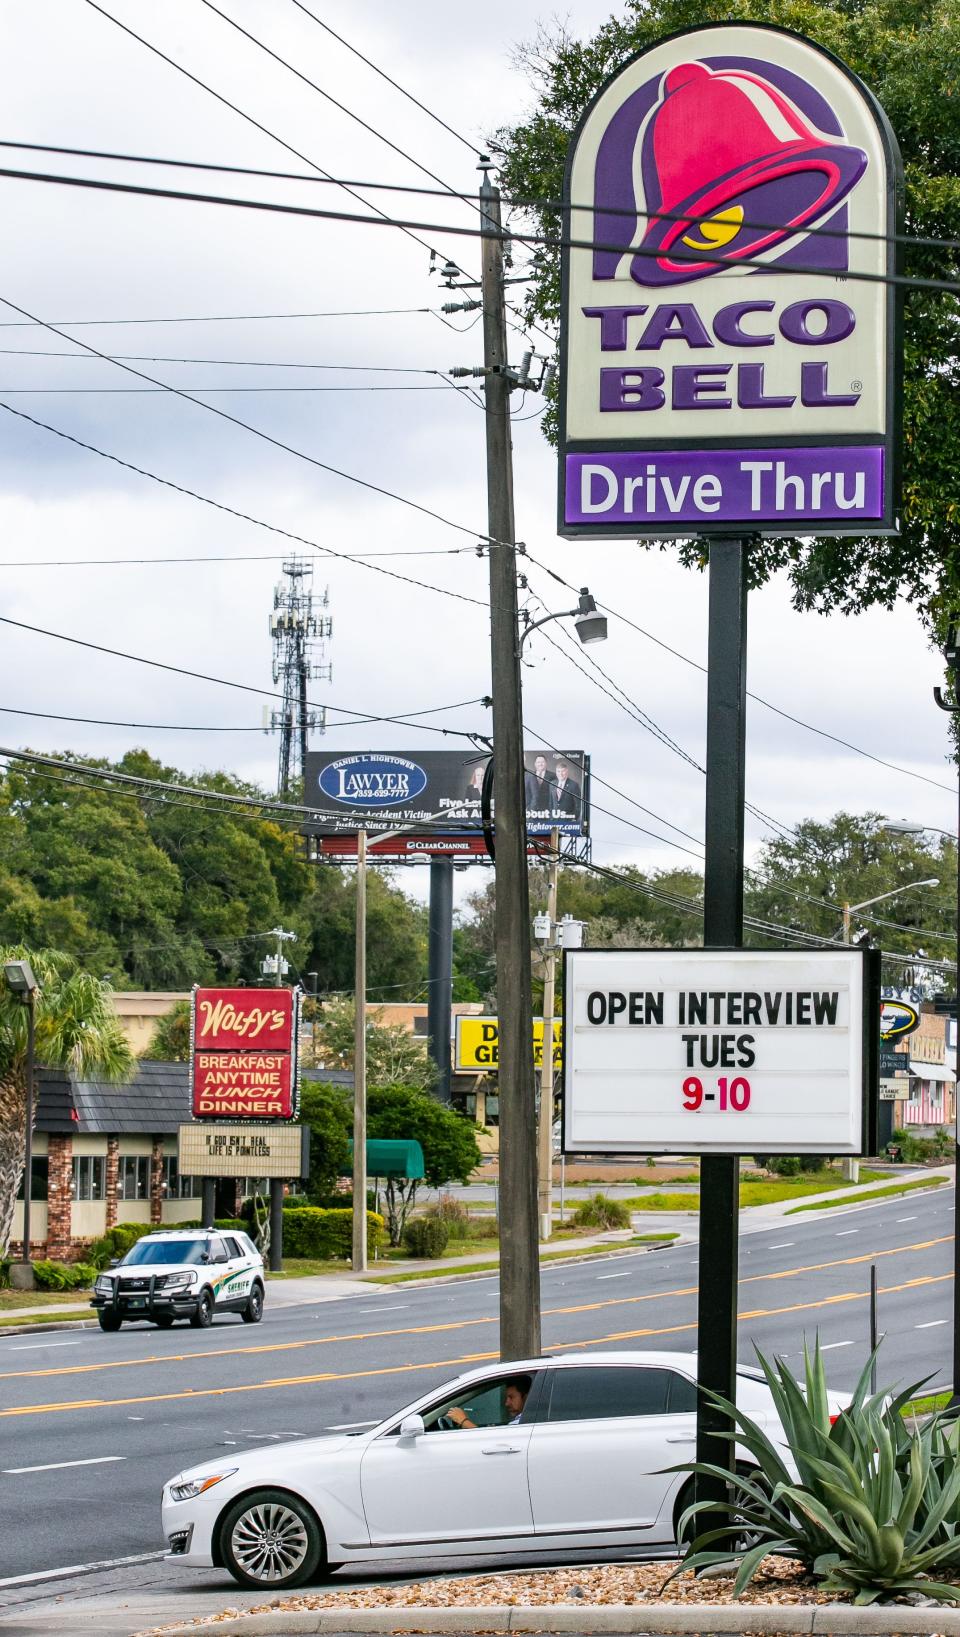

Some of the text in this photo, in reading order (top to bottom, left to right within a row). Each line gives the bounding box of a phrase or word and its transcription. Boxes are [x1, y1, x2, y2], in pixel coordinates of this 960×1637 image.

[581, 299, 856, 351] TACO
[599, 361, 861, 412] BELL
[580, 461, 866, 514] Drive Thru
[332, 757, 360, 769] DANIEL
[370, 755, 416, 771] HIGHTOWER
[447, 808, 469, 818] Ask
[526, 809, 550, 819] bout
[364, 821, 388, 830] Since
[587, 991, 839, 1026] OPEN INTERVIEW
[681, 1034, 756, 1068] TUES
[200, 1057, 285, 1070] BREAKFAST
[204, 1072, 281, 1085] ANYTIME
[201, 1087, 283, 1098] LUNCH
[682, 1076, 751, 1112] 9-10
[200, 1101, 283, 1113] DINNER
[250, 1136, 267, 1146] REAL
[208, 1145, 223, 1156] LIFE
[225, 1145, 233, 1156] IS
[227, 1280, 250, 1293] SHERIFF
